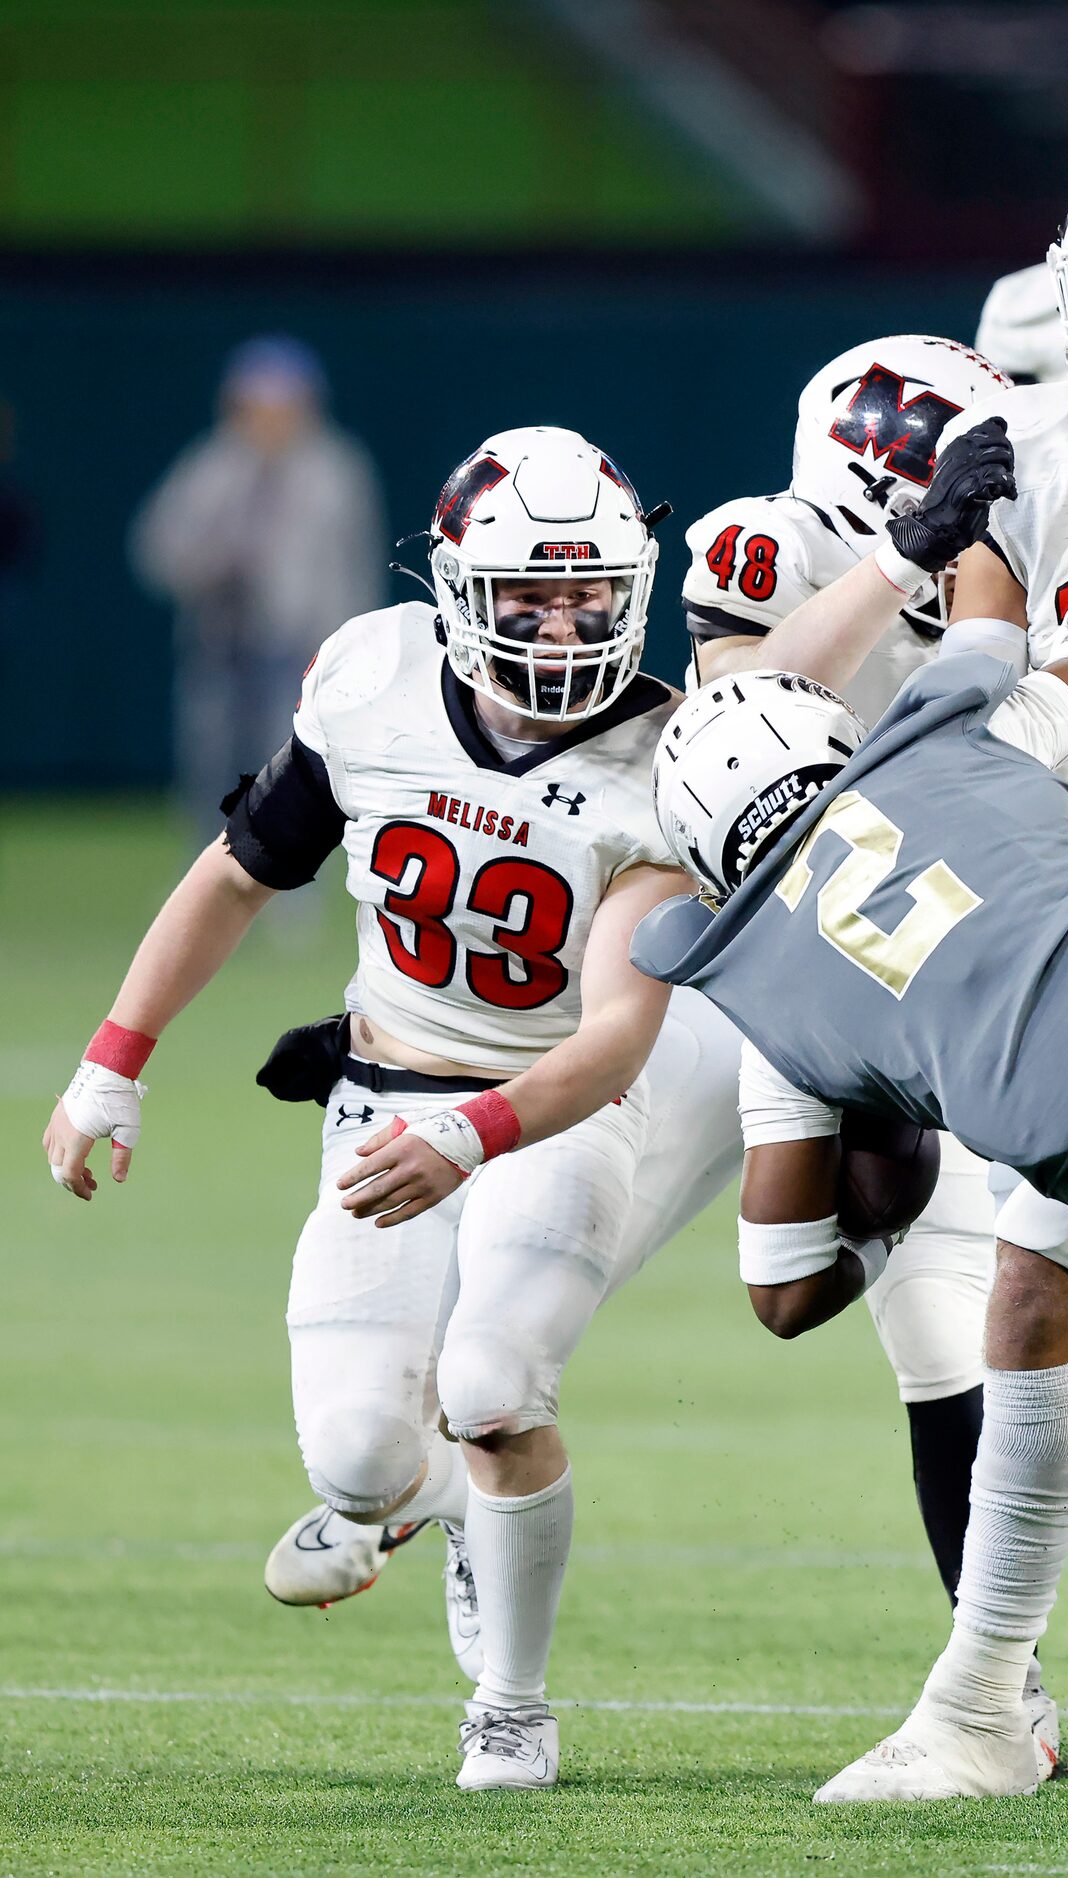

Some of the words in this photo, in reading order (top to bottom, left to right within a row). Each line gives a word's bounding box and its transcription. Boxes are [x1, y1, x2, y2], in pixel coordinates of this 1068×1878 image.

[543, 544, 590, 560] TTH
[706, 524, 779, 602] 48
[427, 791, 530, 847] MELISSA
[370, 820, 574, 1010] 33
[774, 789, 985, 1001] 2
